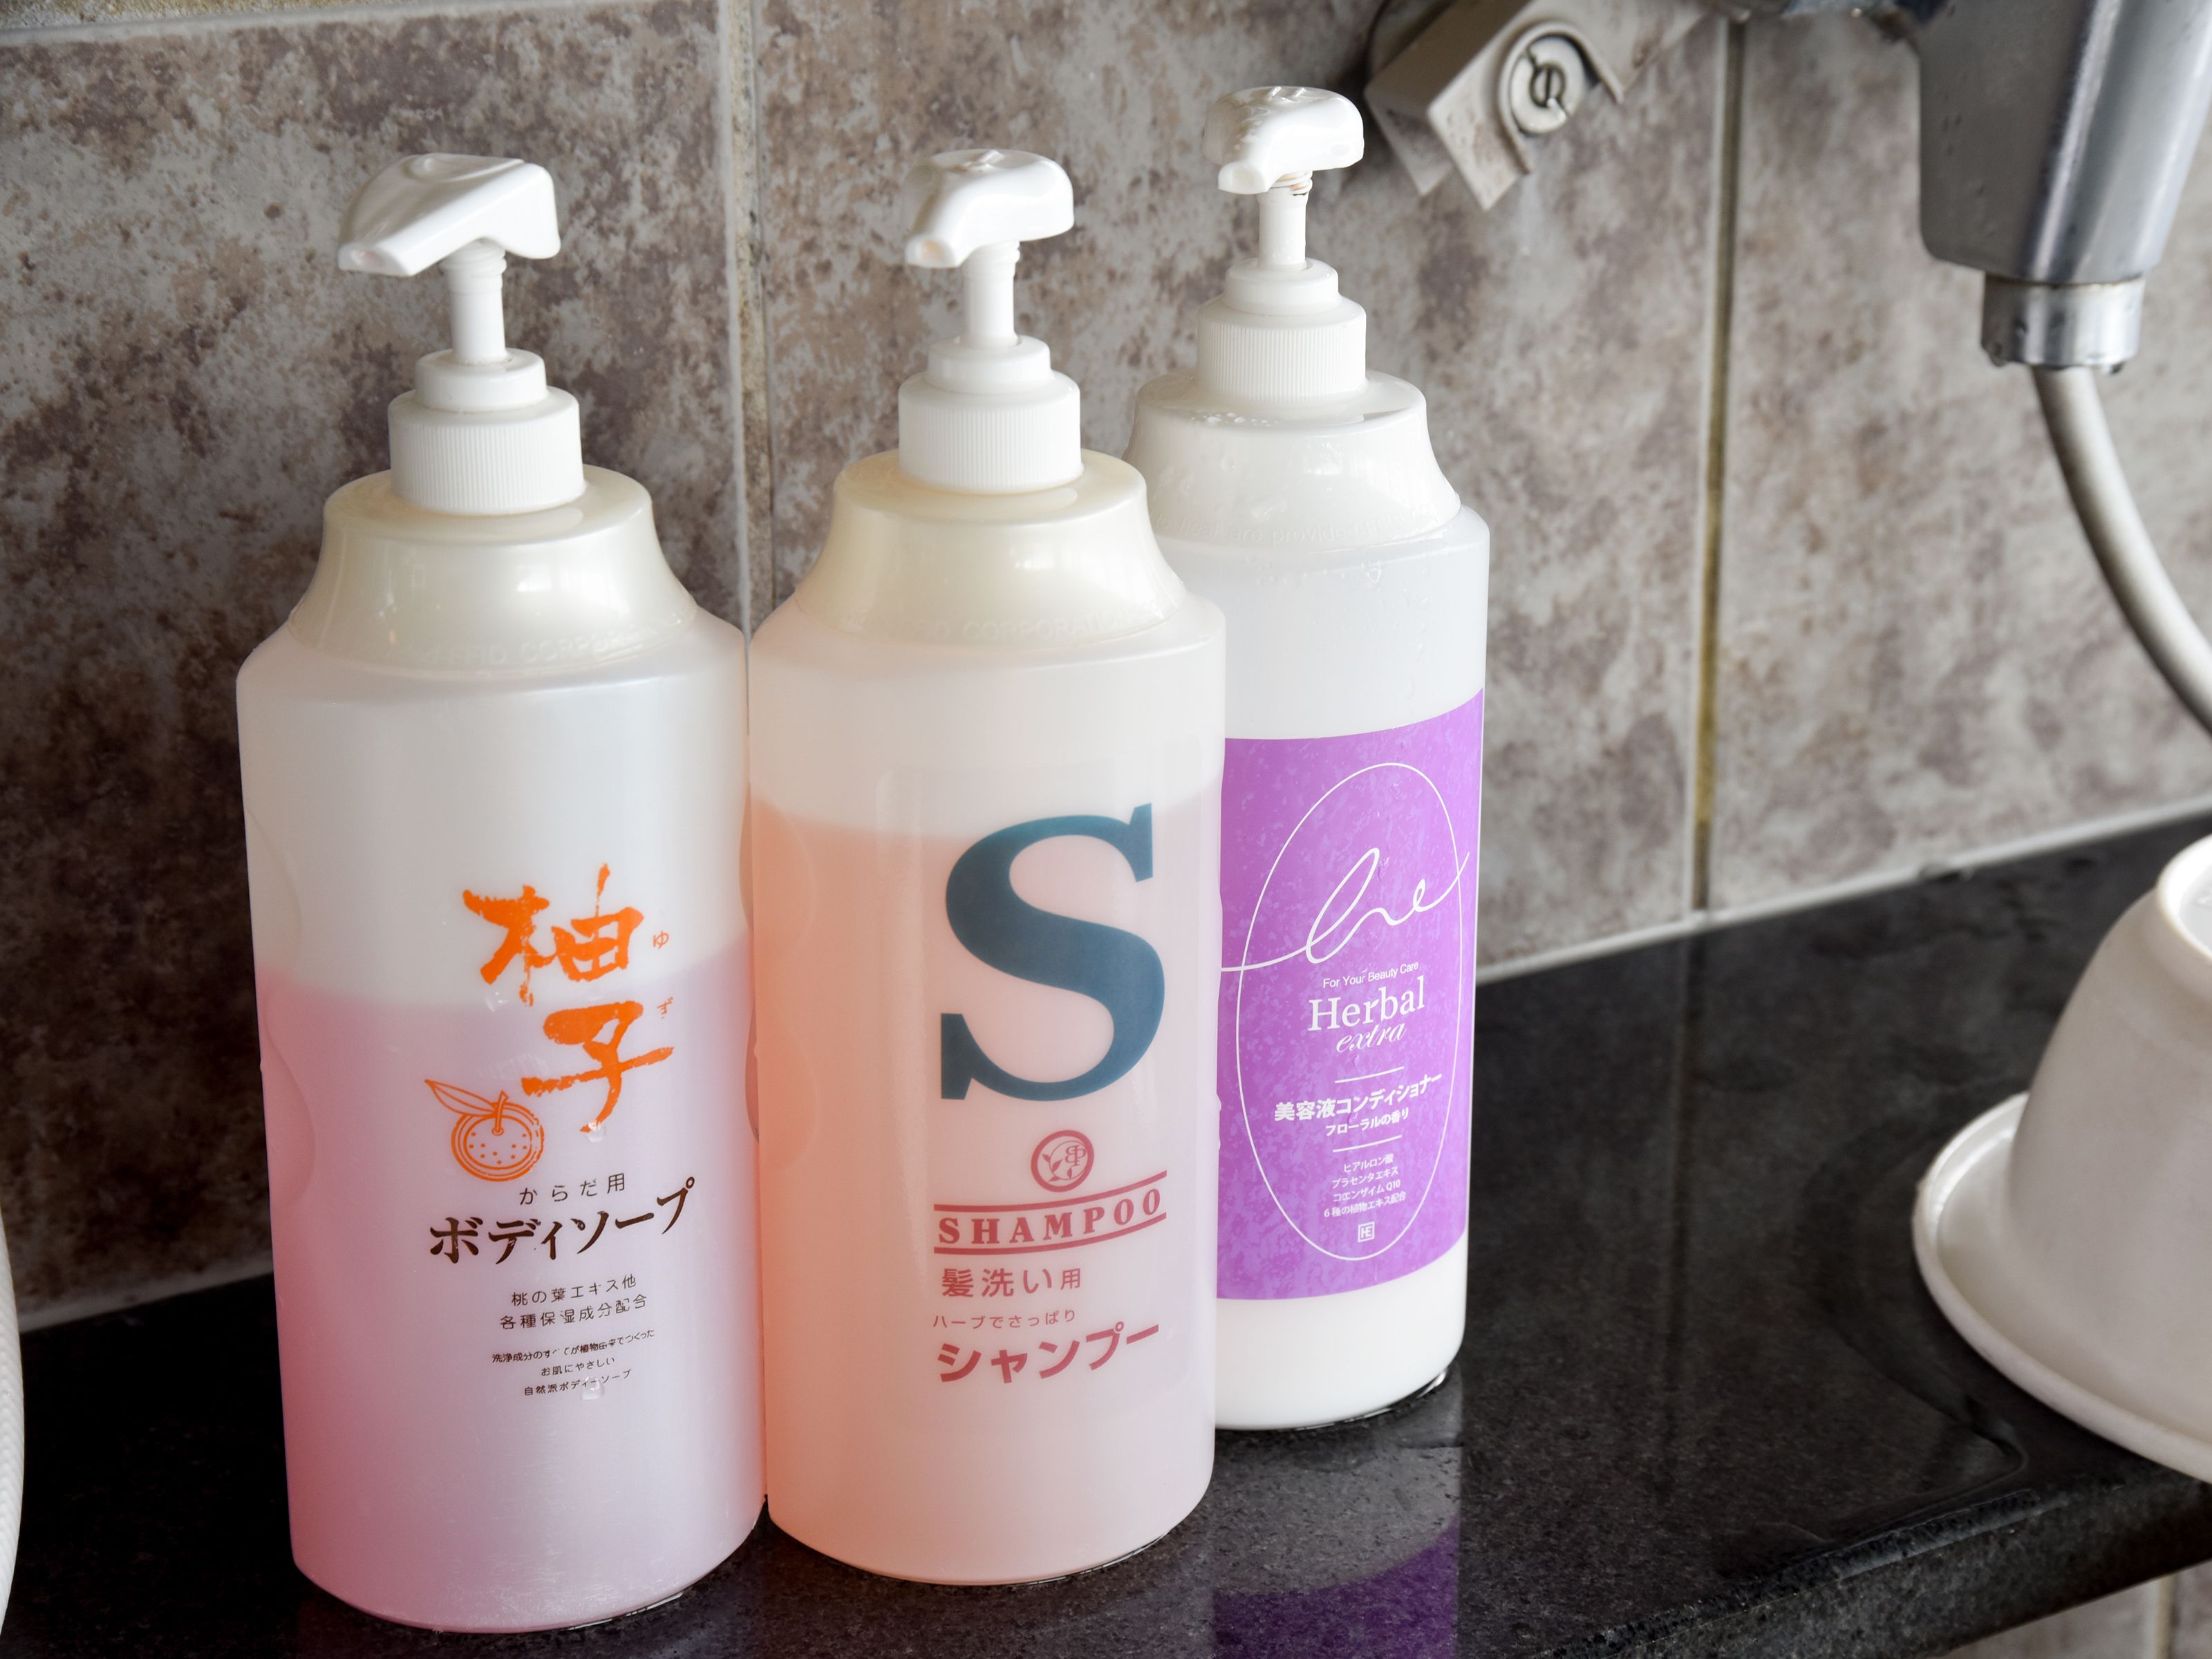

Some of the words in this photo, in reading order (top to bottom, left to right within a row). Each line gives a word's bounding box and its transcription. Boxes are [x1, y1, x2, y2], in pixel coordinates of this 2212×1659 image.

[941, 803, 1165, 1102] S
[1323, 978, 1340, 988] For
[1343, 975, 1365, 986] Your
[1368, 968, 1398, 982] Beauty
[1400, 962, 1419, 974] Care
[462, 863, 674, 1134] 柚子
[1308, 975, 1425, 1031] Herbal
[1336, 1022, 1407, 1053] extra
[1274, 1073, 1442, 1122] 美容液コンディショナー
[1325, 1107, 1409, 1136] フローラルの香り
[519, 1173, 626, 1206] からだ用
[1386, 1179, 1401, 1191] Q10
[430, 1177, 695, 1265] ボディソープ
[939, 1188, 1161, 1244] SHAMPOO
[511, 1273, 637, 1307] 桃の葉エキス他
[941, 1268, 1081, 1298] 髪洗い用
[500, 1293, 648, 1330] 各種保湿成分配合
[933, 1309, 1076, 1329] ハーブでさっぱり
[541, 1356, 616, 1377] お肌にやさしい
[937, 1321, 1159, 1384] シャンプー
